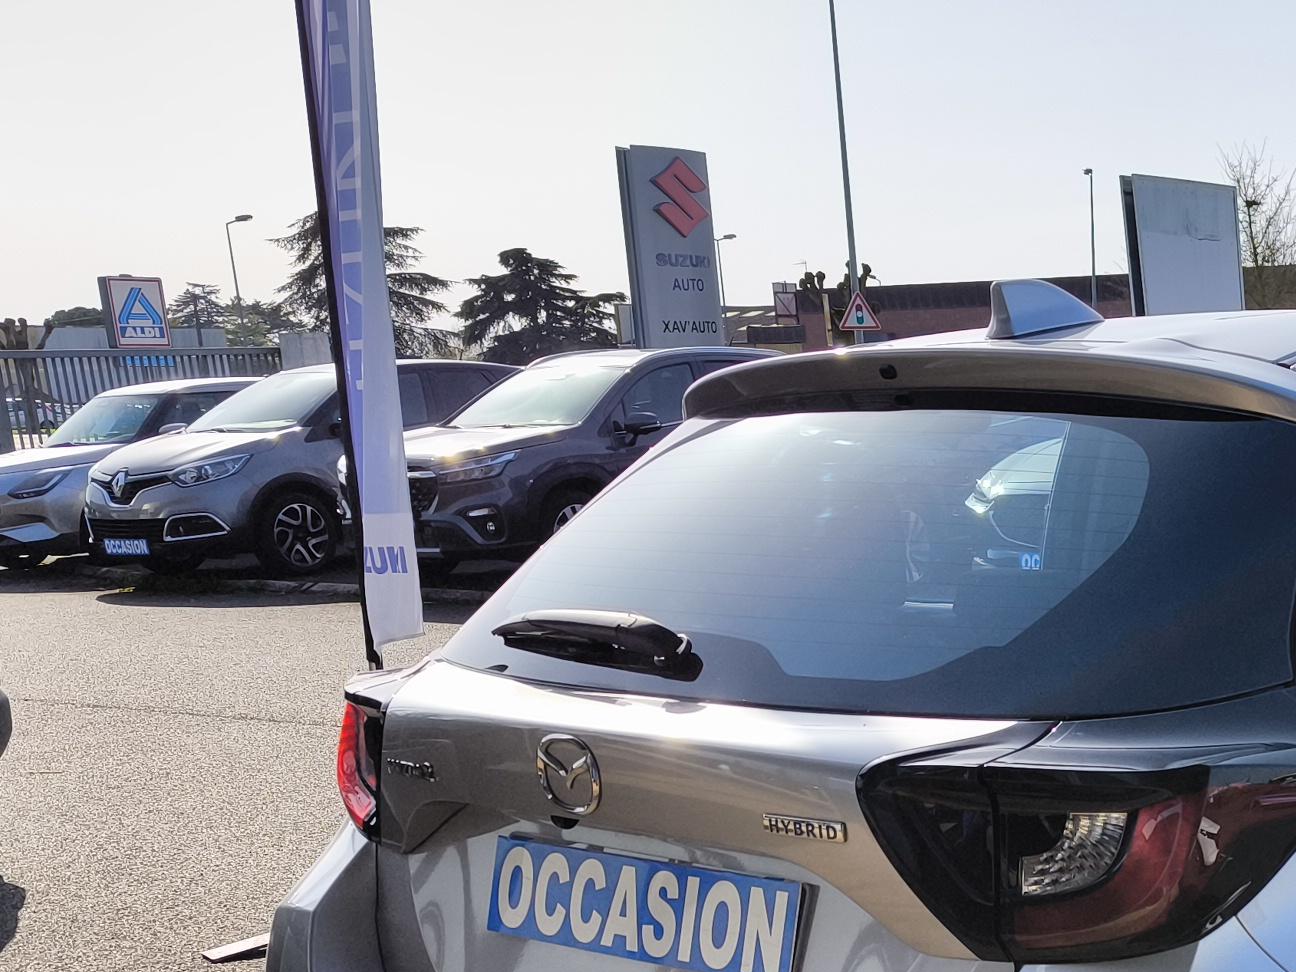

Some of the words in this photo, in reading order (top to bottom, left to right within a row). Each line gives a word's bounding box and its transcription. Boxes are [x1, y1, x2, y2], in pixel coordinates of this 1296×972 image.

[655, 252, 711, 269] SUZUKI
[672, 278, 704, 292] AUTO
[124, 327, 161, 338] ALDI
[663, 320, 718, 334] XAV'AUTO
[104, 539, 149, 555] OCCASION
[768, 818, 838, 840] HYBRID
